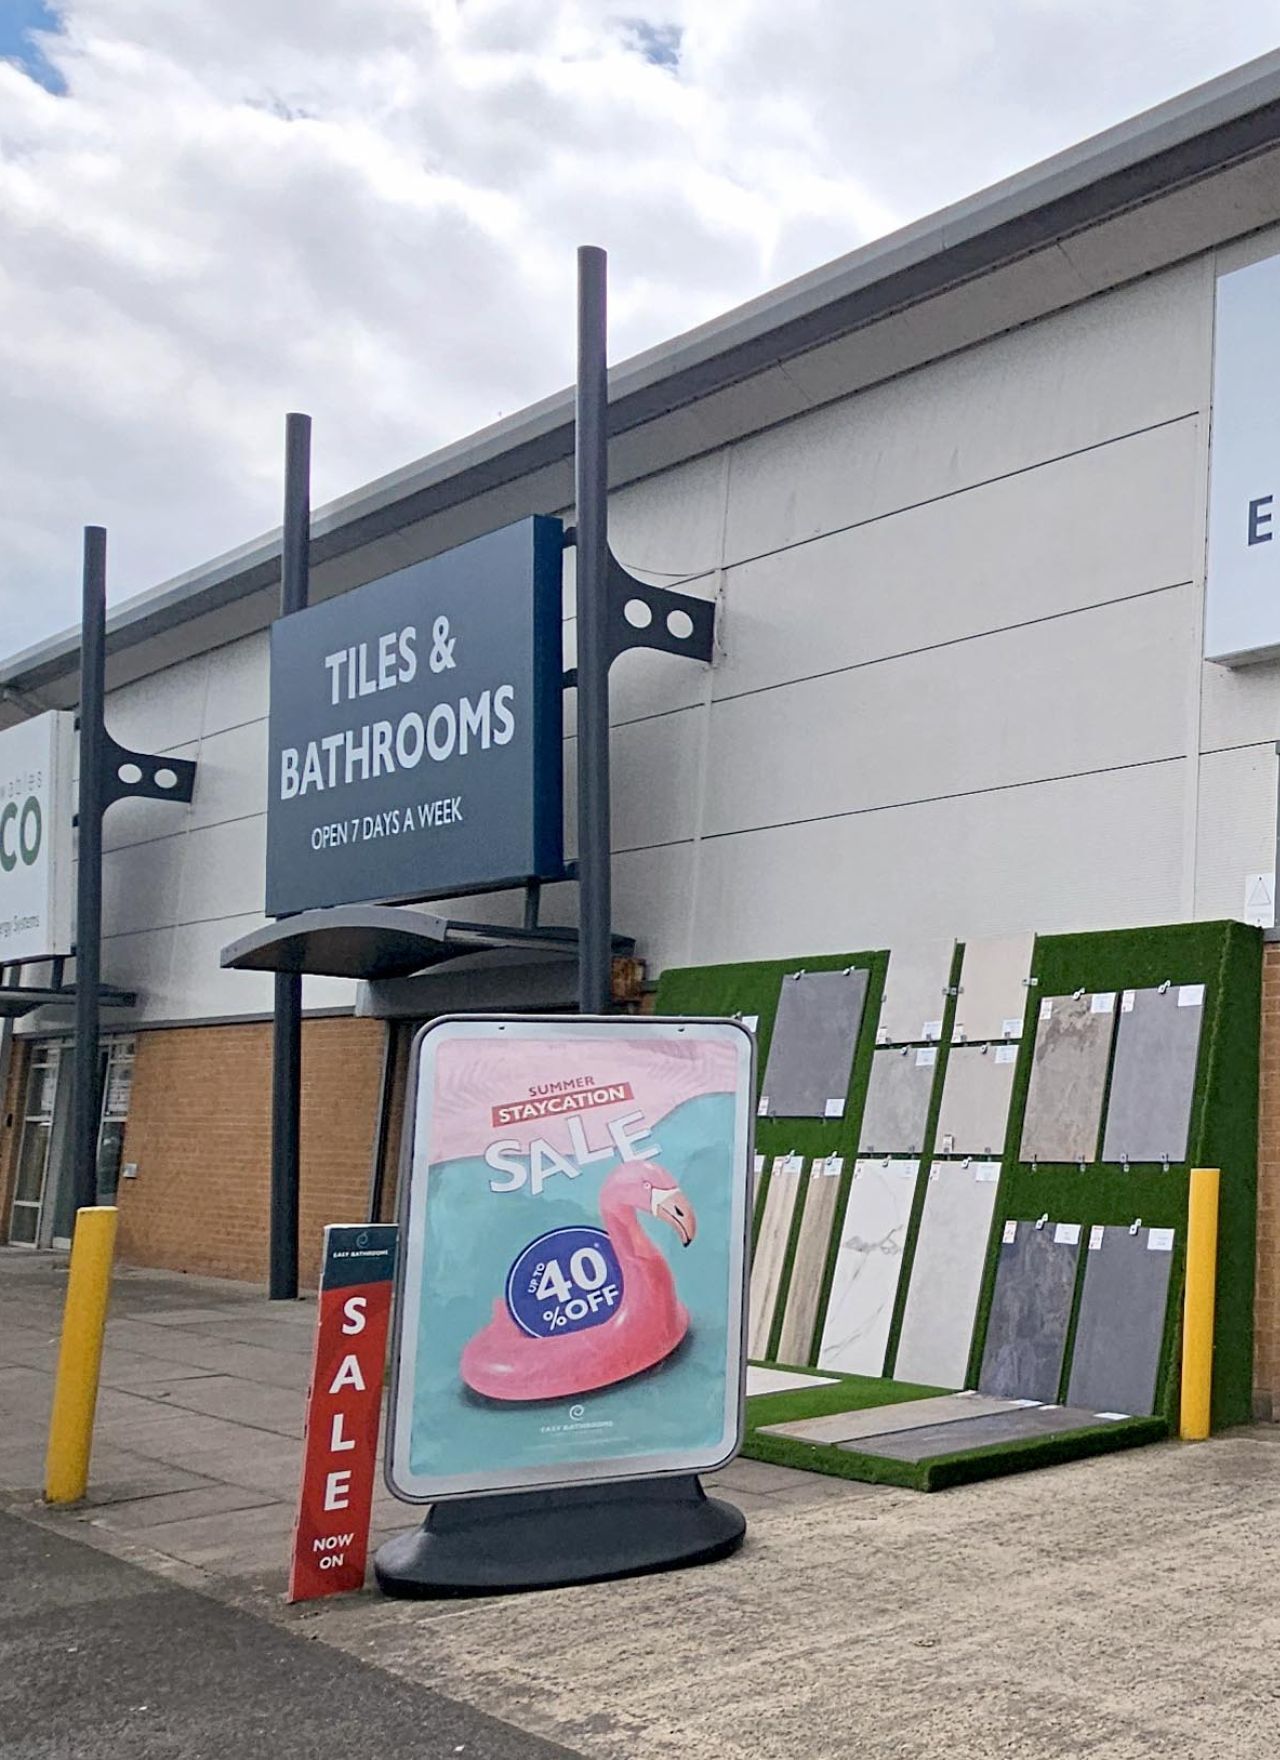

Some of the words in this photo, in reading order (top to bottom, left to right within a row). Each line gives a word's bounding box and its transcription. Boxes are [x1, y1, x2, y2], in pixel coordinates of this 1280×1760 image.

[325, 626, 417, 705] TILES
[429, 615, 456, 673] &
[281, 685, 515, 800] BATHROOMS
[311, 821, 348, 850] OPEN
[352, 819, 359, 842] 7
[363, 810, 400, 840] DAYS
[403, 808, 415, 832] A
[418, 796, 463, 827] WEEK
[528, 1075, 595, 1098] SUMMER
[498, 1085, 626, 1124] STAYCATION
[484, 1109, 663, 1195] SALE
[533, 1263, 545, 1277] TO
[528, 1279, 539, 1294] UP
[313, 1533, 354, 1552] NOW
[319, 1553, 344, 1570] ON
